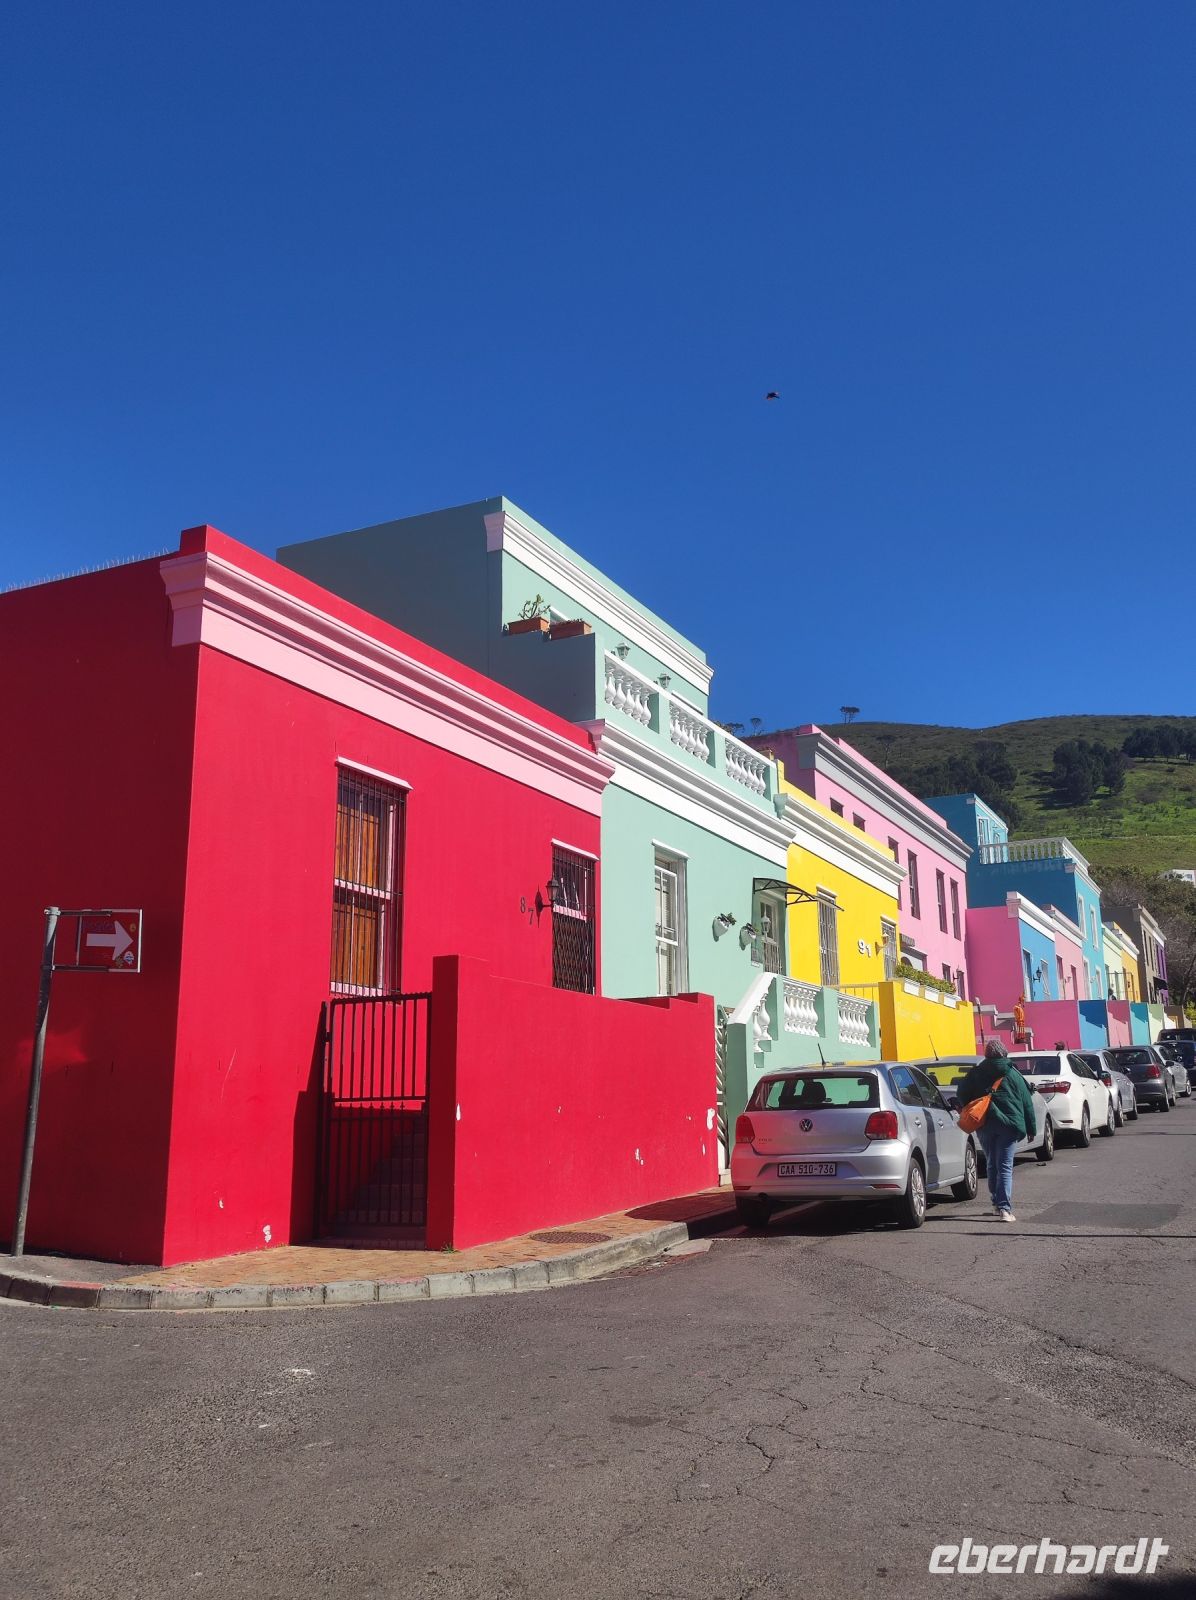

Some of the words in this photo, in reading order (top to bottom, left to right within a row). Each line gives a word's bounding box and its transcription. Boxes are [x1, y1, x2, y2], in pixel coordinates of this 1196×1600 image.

[520, 896, 535, 925] 87
[780, 1165, 796, 1175] CAA
[798, 1164, 834, 1174] 510-736
